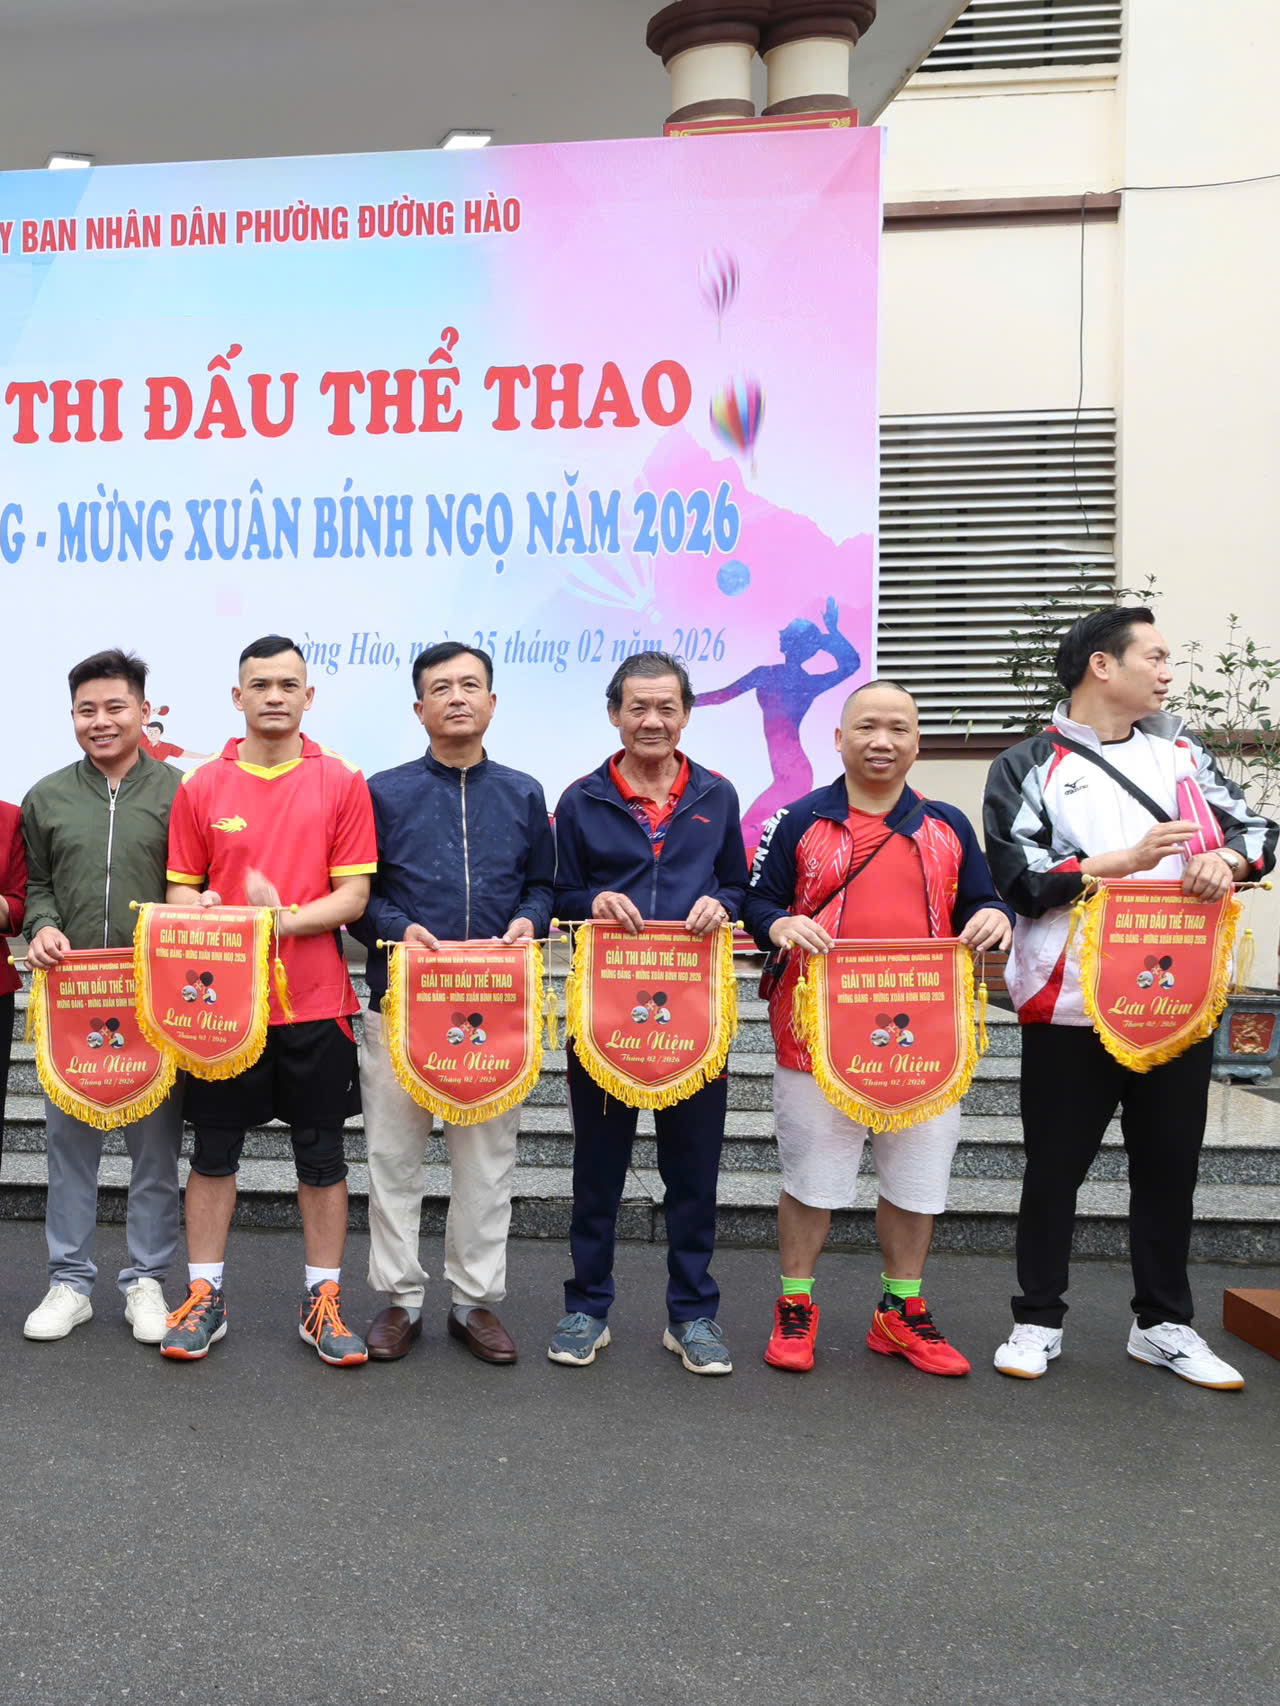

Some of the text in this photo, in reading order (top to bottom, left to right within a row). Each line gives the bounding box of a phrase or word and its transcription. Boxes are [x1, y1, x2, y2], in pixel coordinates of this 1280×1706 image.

[22, 219, 76, 253] BAN
[86, 209, 161, 250] NHÂN
[171, 206, 226, 247] DÂN
[236, 200, 348, 243] PHƯỜNG
[357, 195, 454, 239] ĐƯỜNG
[465, 192, 520, 233] HÀO
[5, 378, 124, 444] THI
[144, 343, 299, 440] ĐẤU
[320, 326, 463, 436] THỂ
[484, 359, 692, 431] THAO
[58, 483, 173, 562] MỪNG
[185, 478, 301, 561] XUÂN
[313, 477, 414, 559] BÍNH
[425, 491, 513, 575] NGỌ
[526, 470, 622, 556] NĂM
[632, 482, 740, 557] 2026
[347, 632, 401, 672] Hào,
[503, 629, 570, 673] tháng
[577, 628, 605, 663] 02
[611, 628, 663, 662] năm
[673, 627, 727, 662] 2026
[749, 808, 789, 887] VIET NAM
[1108, 996, 1192, 1019] Lưu Niệm
[163, 1008, 238, 1034] Lưu Niệm
[605, 1030, 695, 1054] Lưu Niệm
[66, 1055, 147, 1076] Lưu Niệm
[423, 1051, 511, 1074] Lưu Niệm
[846, 1054, 941, 1076] Lưu Niệm
